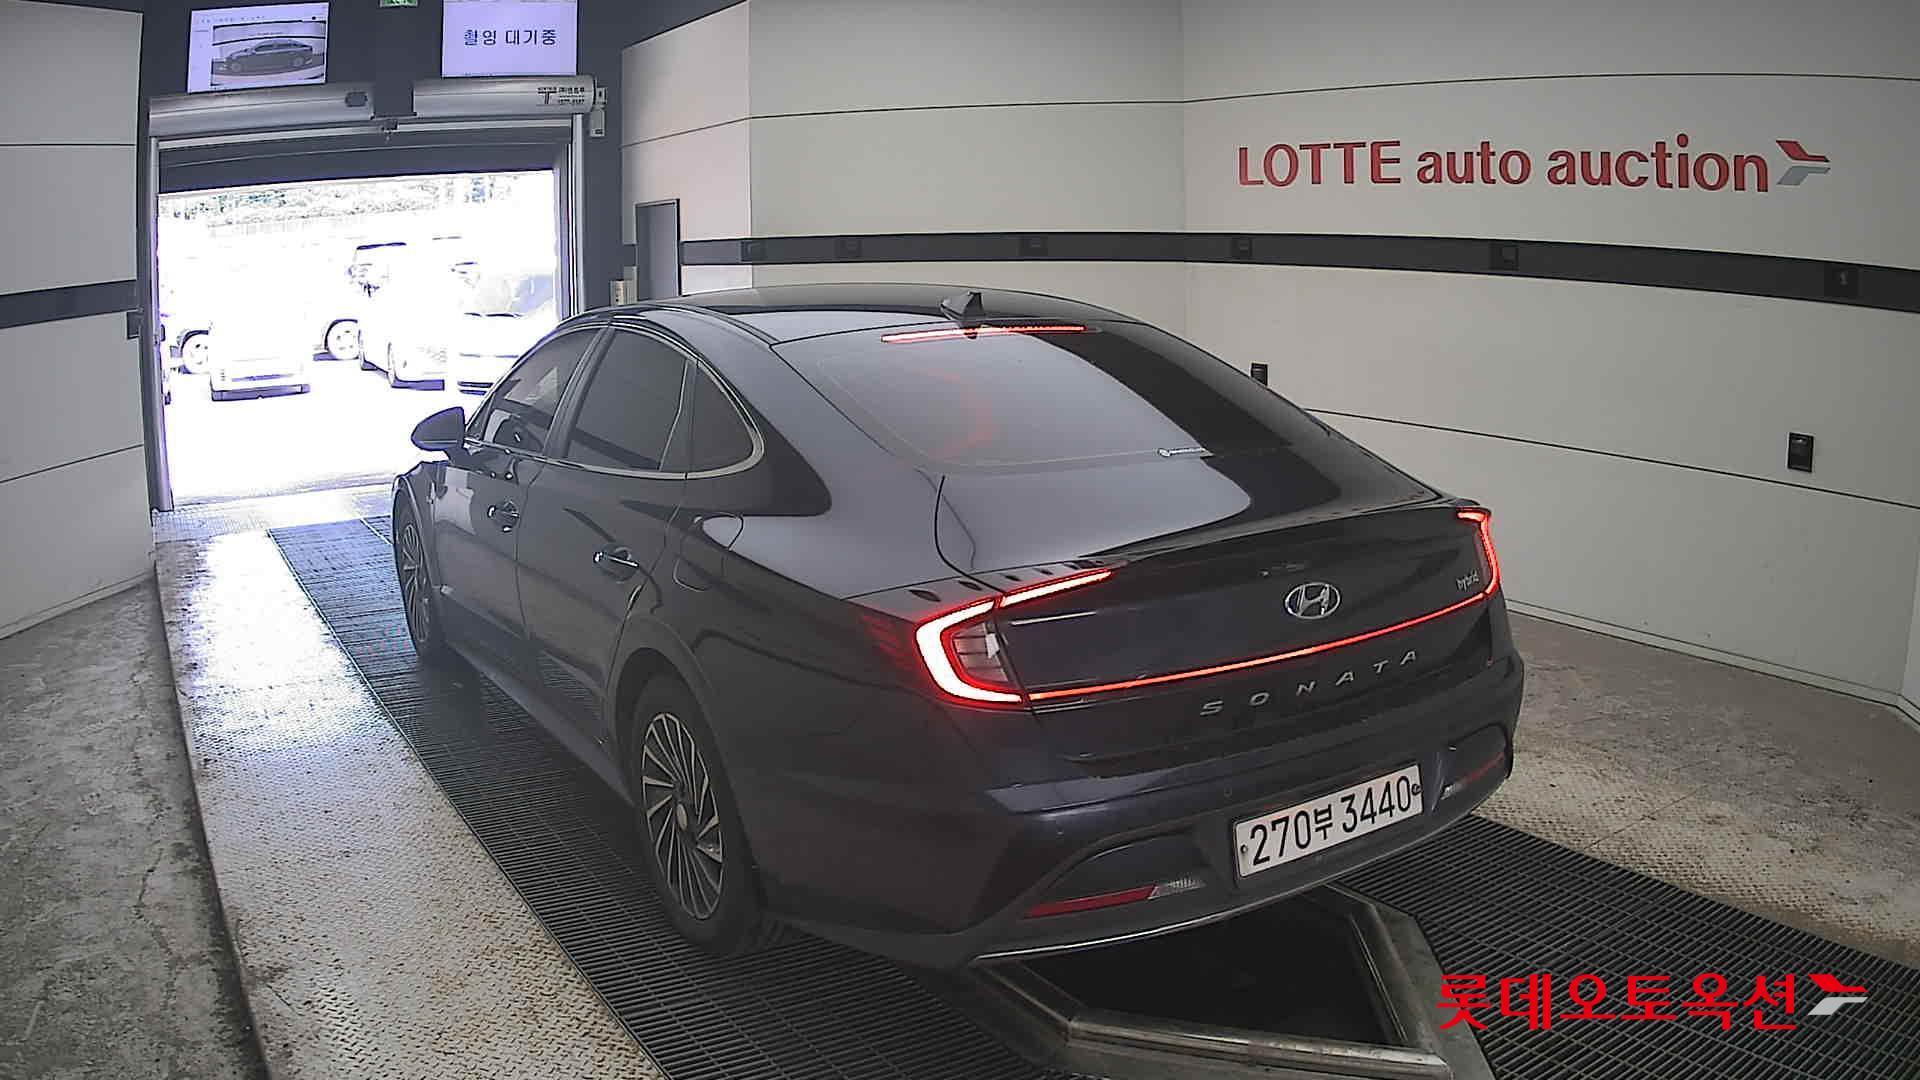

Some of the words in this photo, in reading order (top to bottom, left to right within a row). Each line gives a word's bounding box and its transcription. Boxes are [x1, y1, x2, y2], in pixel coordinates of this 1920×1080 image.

[505, 29, 557, 46] 대기중
[1238, 140, 1401, 187] LOTTE
[1416, 141, 1532, 185] auto
[1547, 133, 1769, 192] auction
[1199, 650, 1417, 717] SONATA
[1249, 803, 1333, 866] 270부
[1340, 775, 1411, 834] 3440
